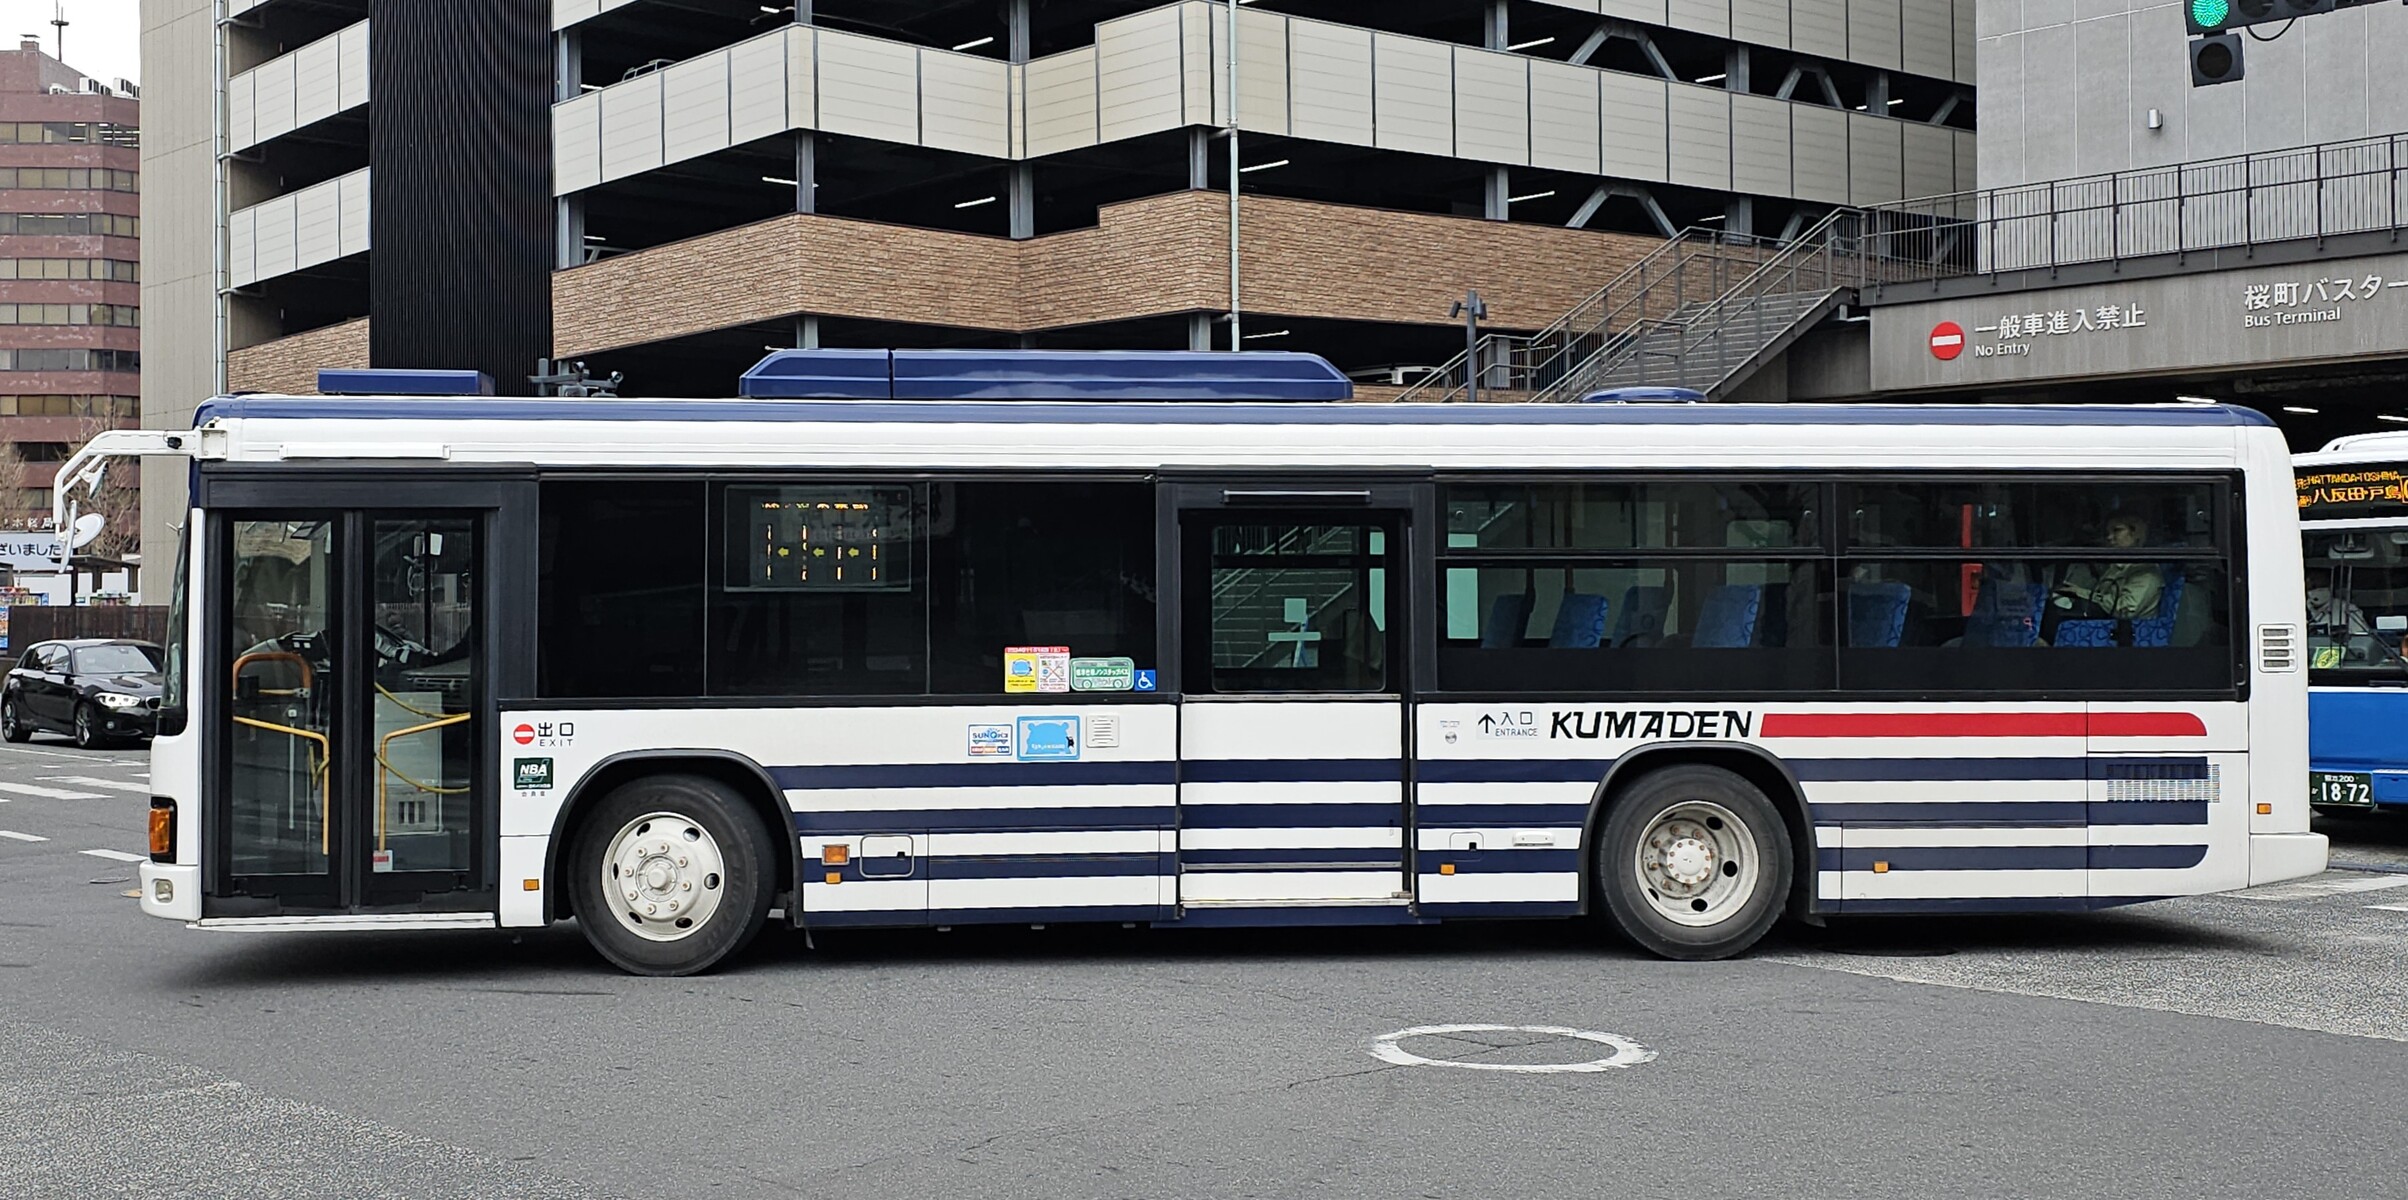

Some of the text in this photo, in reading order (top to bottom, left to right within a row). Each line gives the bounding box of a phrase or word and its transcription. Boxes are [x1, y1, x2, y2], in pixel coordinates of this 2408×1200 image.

[2244, 274, 2408, 310] 桜町バスター
[1975, 303, 2147, 340] 一般車進入禁止
[2245, 306, 2341, 328] Bus Terminal
[1975, 342, 2031, 357] No Entry
[1501, 711, 1533, 726] 入口
[1550, 711, 1752, 739] KUMADEN
[538, 722, 574, 737] 出口
[1495, 728, 1538, 737] ENTRANCE
[539, 739, 573, 747] EXIT
[520, 764, 548, 777] NBA
[2339, 775, 2355, 783] 200
